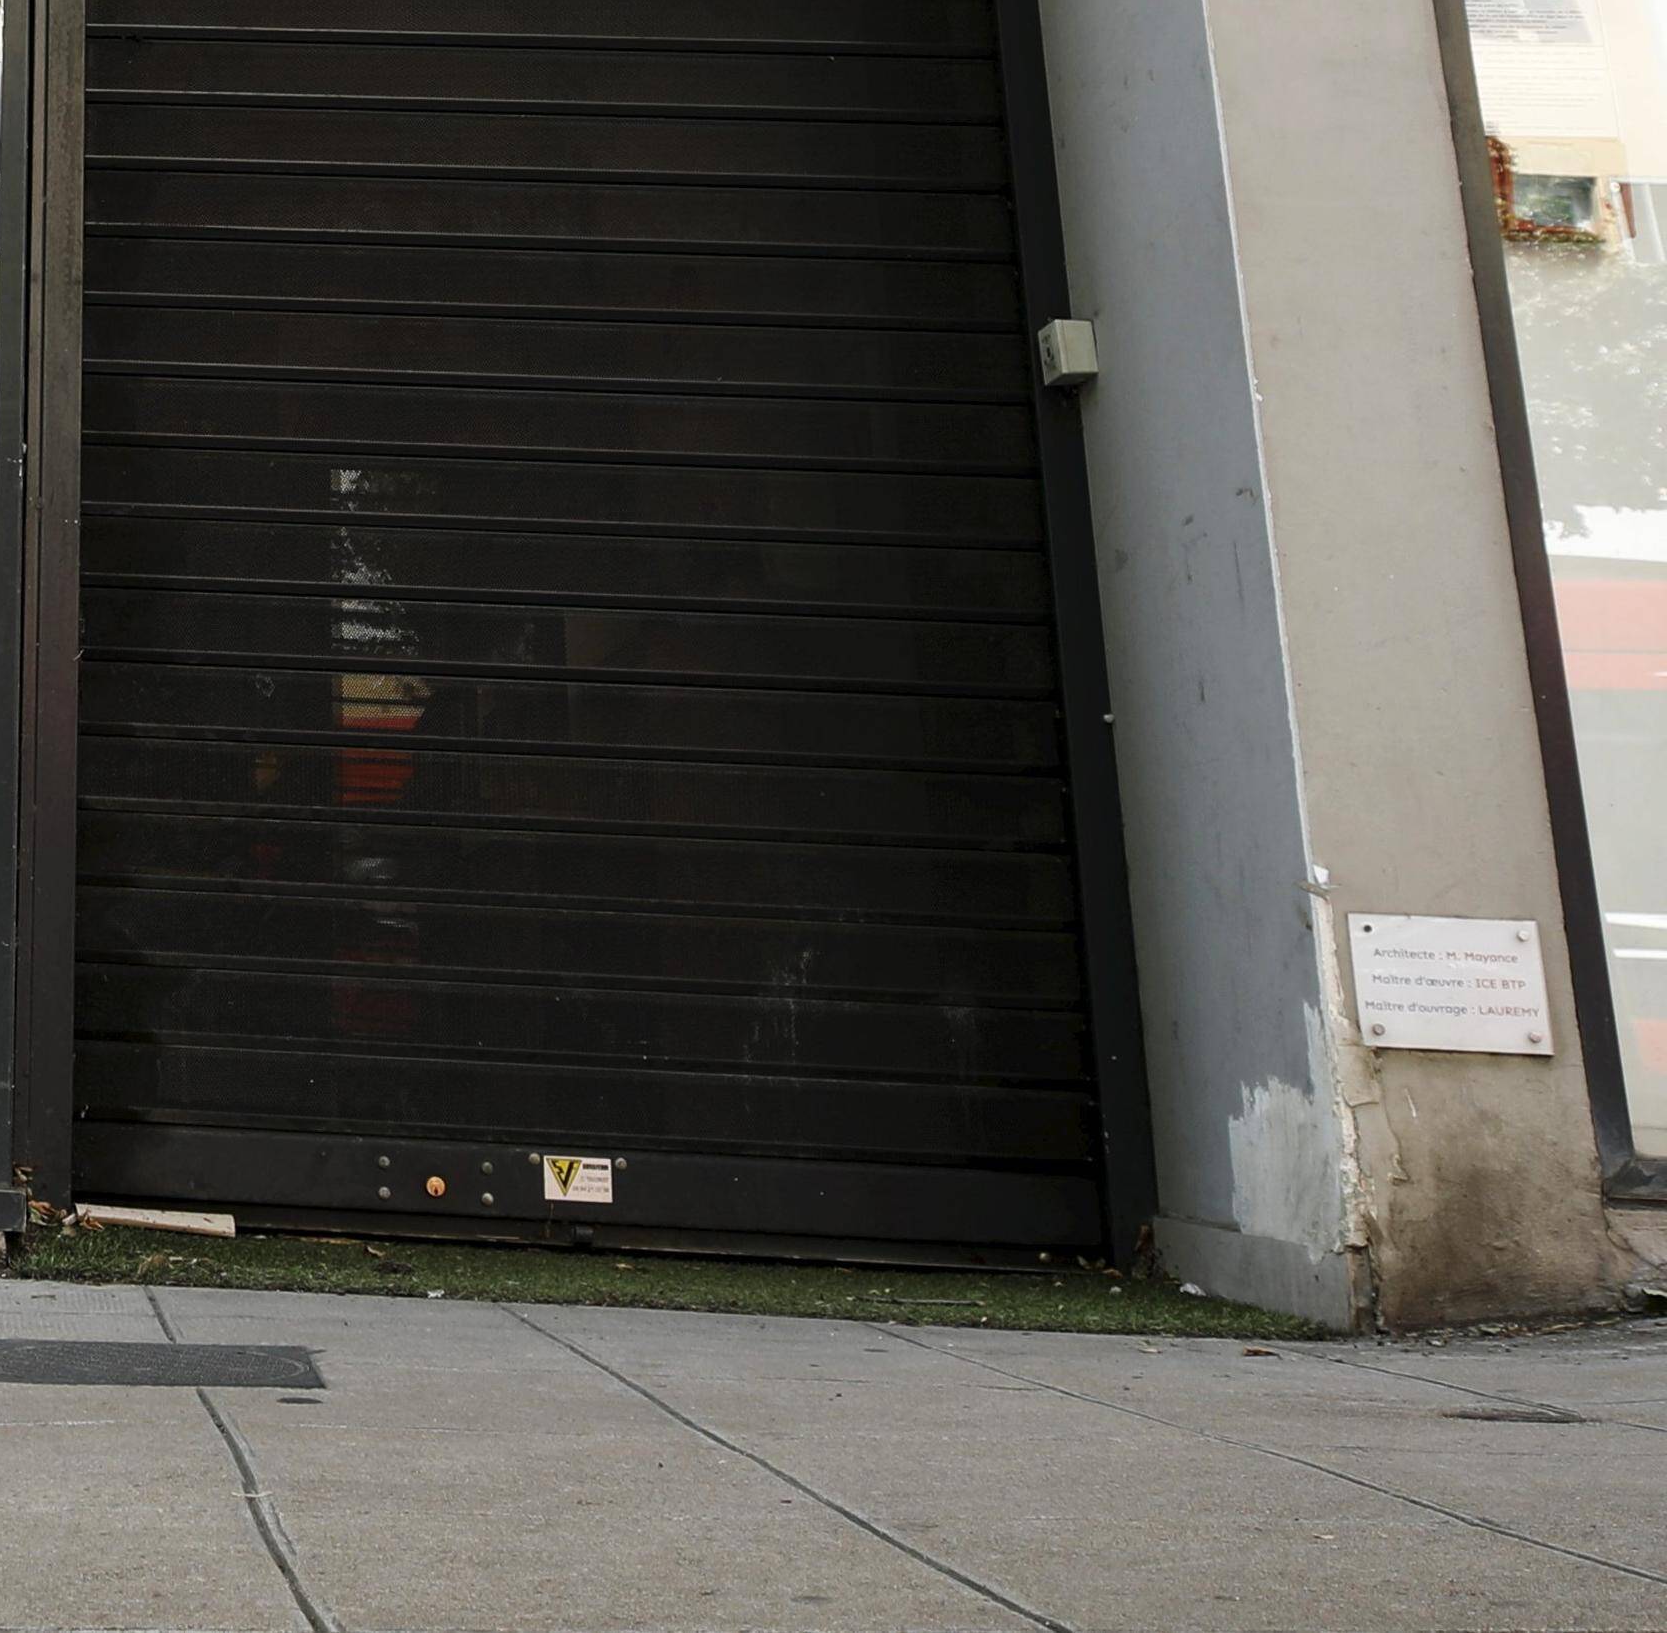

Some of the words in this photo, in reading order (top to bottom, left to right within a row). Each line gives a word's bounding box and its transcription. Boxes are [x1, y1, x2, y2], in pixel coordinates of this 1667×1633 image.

[1373, 947, 1435, 960] Architecte
[1465, 952, 1518, 964] Mayance
[1476, 978, 1497, 989] ICE
[1502, 979, 1526, 990] BTP
[1479, 1005, 1540, 1017] LAUREMY
